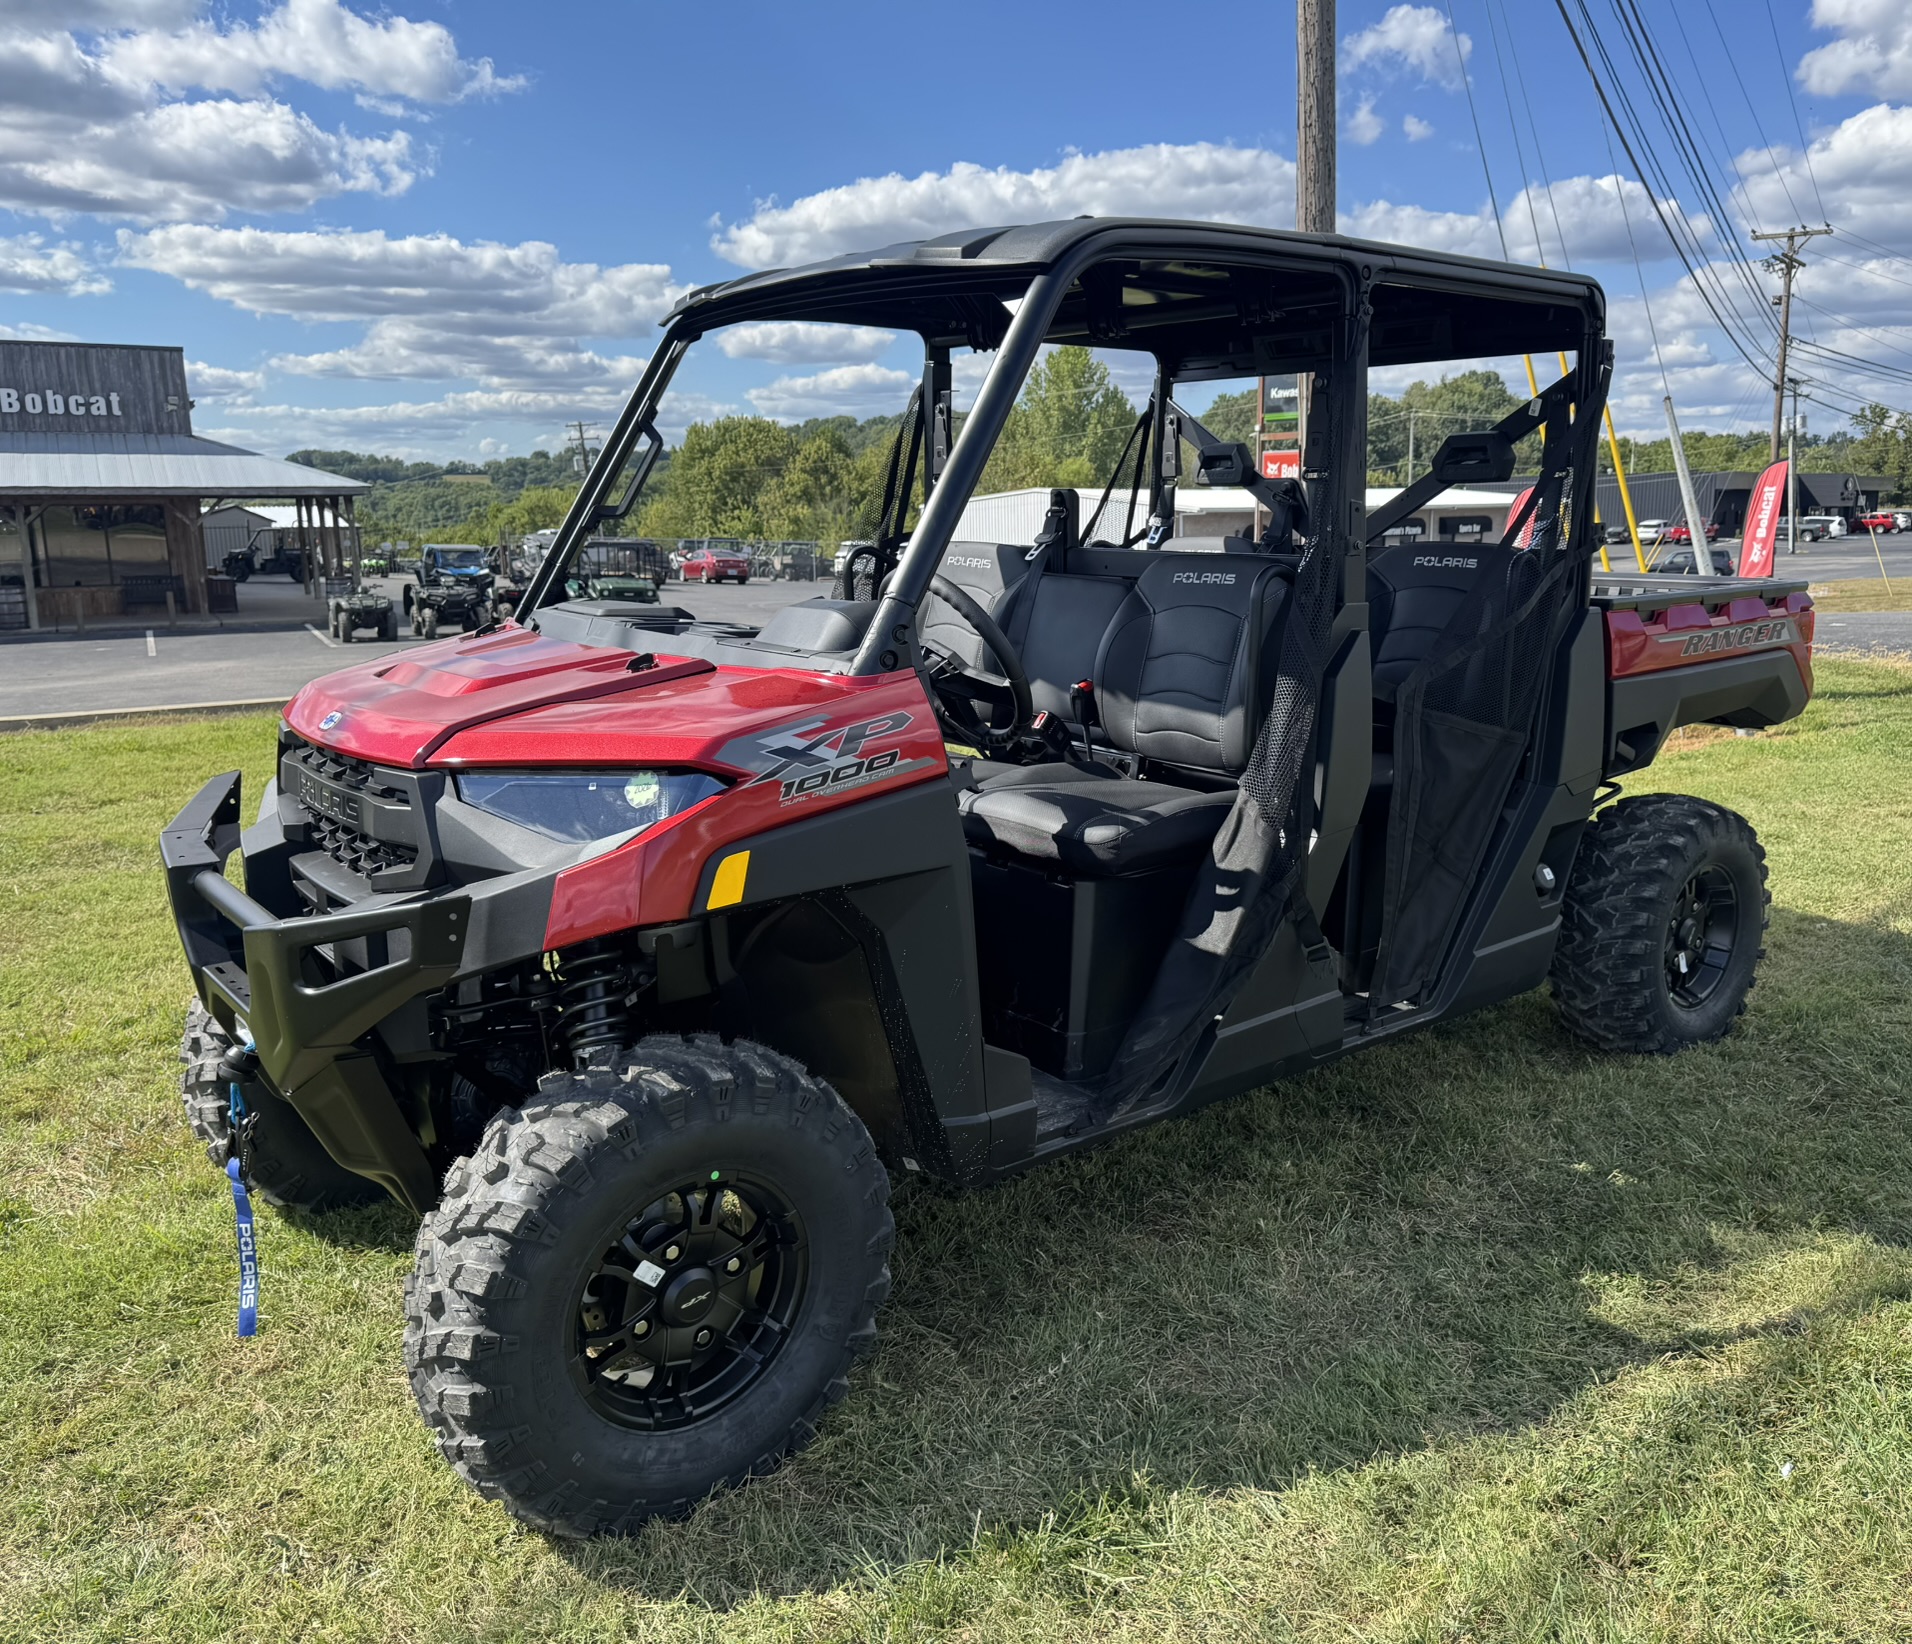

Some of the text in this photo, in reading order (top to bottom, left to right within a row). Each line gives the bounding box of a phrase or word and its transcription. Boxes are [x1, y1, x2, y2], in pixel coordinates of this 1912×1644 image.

[0, 387, 122, 416] Bobcat
[1270, 387, 1299, 400] Kawas
[1281, 463, 1299, 478] Bob
[1756, 485, 1777, 538] Bobcat
[947, 556, 991, 569] POLARIS
[1173, 572, 1236, 585] POLARIS
[1413, 556, 1478, 568] POLARIS
[1681, 620, 1787, 657] RANGER
[743, 711, 914, 788] XP
[779, 749, 900, 801] 1000
[780, 768, 895, 808] DUAL OVERHEAD CAM
[300, 776, 359, 824] POLARIS
[239, 1223, 255, 1309] POLARIS
